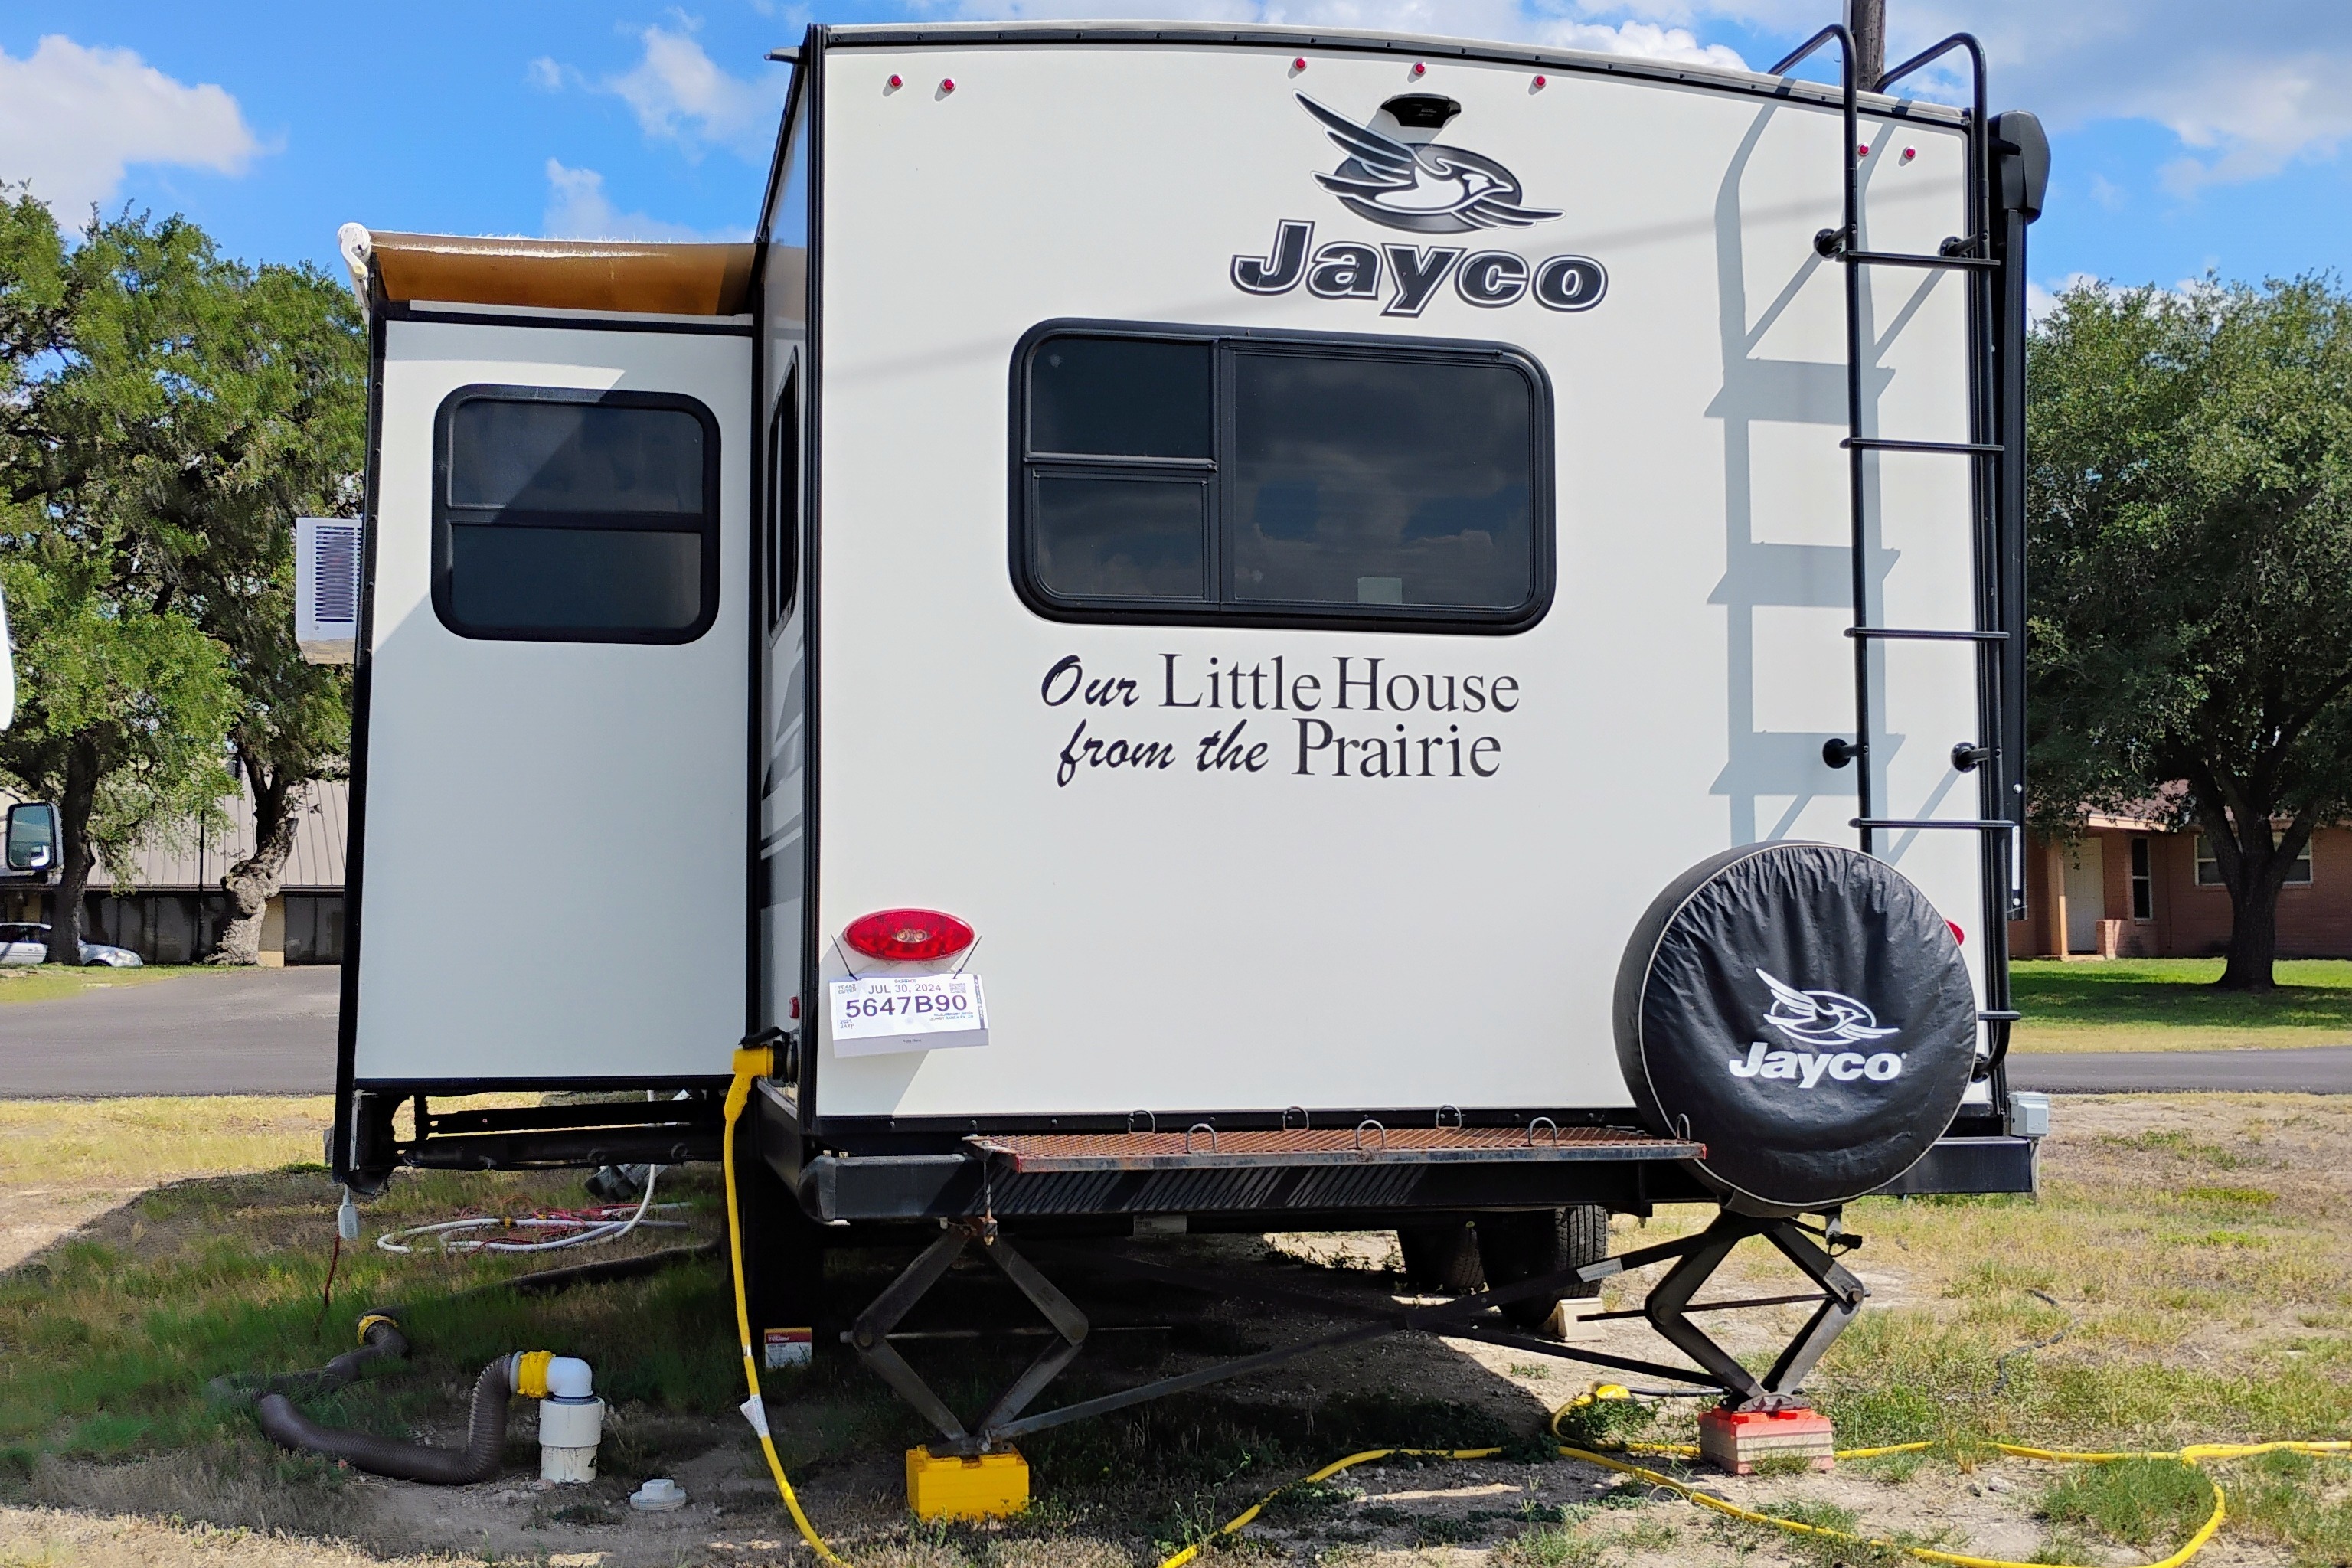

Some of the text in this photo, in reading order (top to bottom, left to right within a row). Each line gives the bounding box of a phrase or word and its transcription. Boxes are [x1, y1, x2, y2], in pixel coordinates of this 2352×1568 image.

[1230, 219, 1609, 318] Jayco
[1041, 653, 1520, 713] Our Little House
[1057, 718, 1501, 788] from the Prairie
[845, 995, 967, 1018] 5647B90
[868, 985, 891, 995] JUL
[915, 984, 942, 992] 2024
[1729, 1041, 1903, 1088] Jayco
